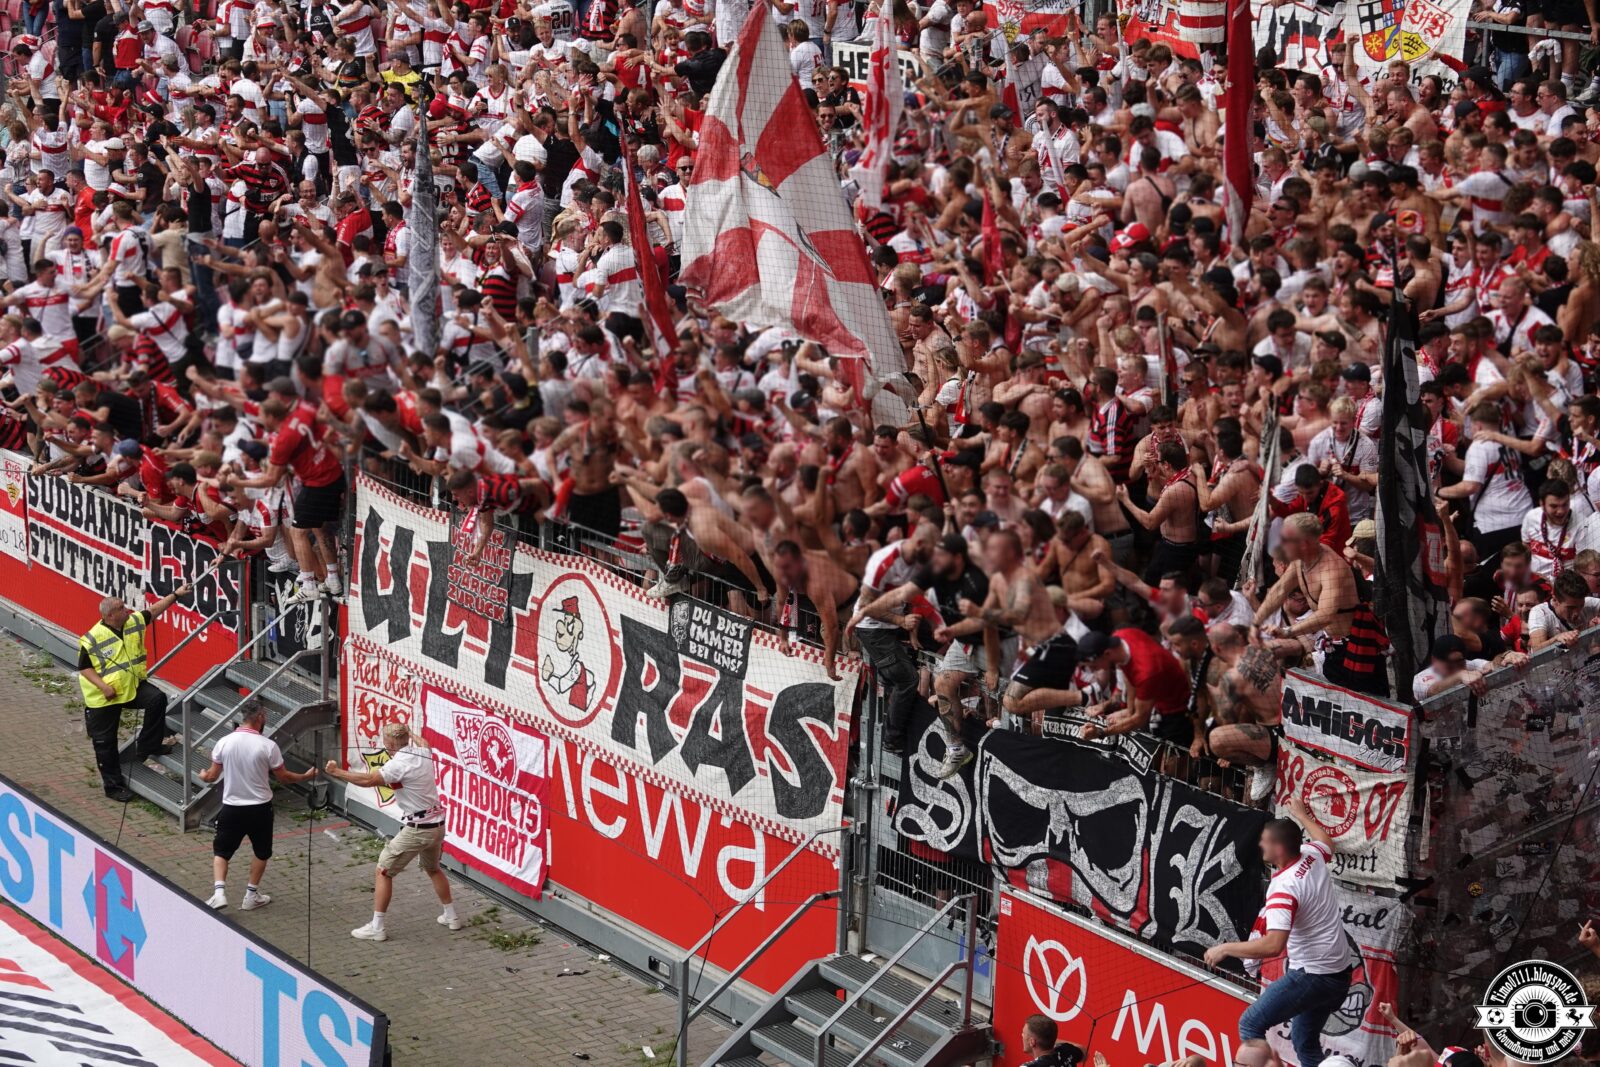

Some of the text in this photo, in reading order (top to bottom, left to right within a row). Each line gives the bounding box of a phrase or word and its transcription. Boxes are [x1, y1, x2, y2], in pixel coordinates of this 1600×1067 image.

[28, 522, 142, 607] STUTTGART
[451, 525, 510, 570] VERNNTE
[453, 549, 504, 585] KHRT
[690, 621, 743, 659] IMMER
[692, 606, 748, 639] DU BIST
[689, 640, 743, 673] BEI UNS!
[469, 773, 539, 834] ADDICTS
[1364, 780, 1408, 842] 07
[439, 794, 529, 869] STUTTGART
